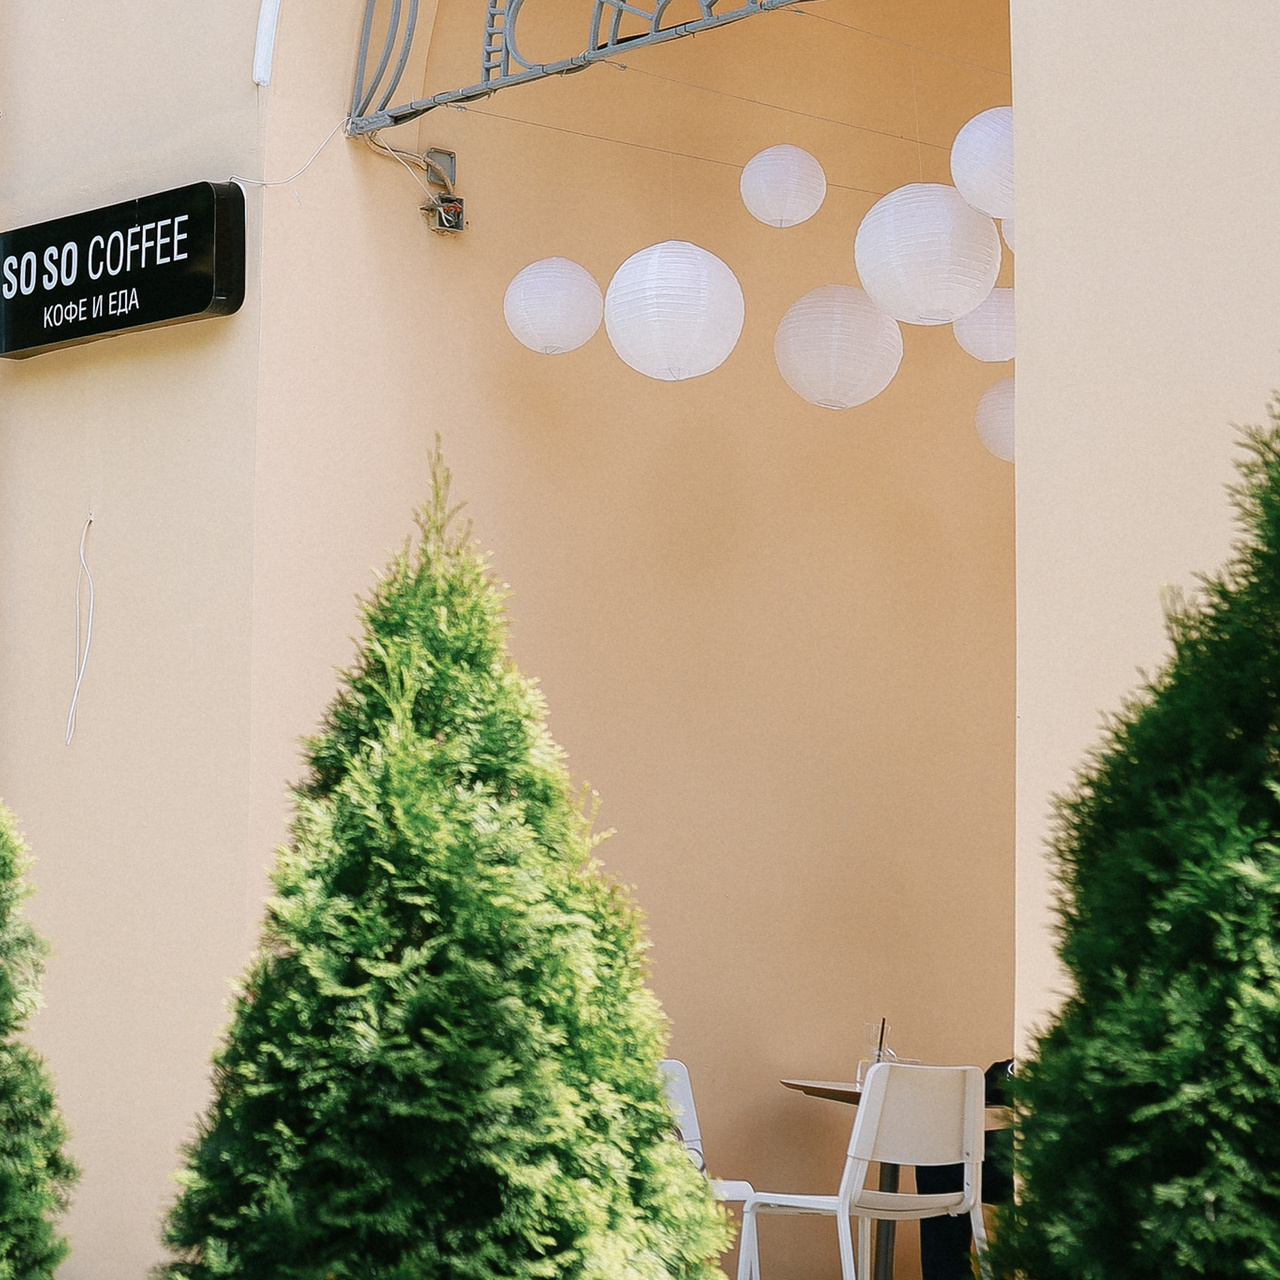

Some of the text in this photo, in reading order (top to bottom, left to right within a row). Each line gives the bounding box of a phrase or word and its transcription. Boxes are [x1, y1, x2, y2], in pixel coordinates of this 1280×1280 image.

[2, 214, 189, 300] SO SO COFFEE
[43, 287, 140, 329] КОФЕ И ЕДА
